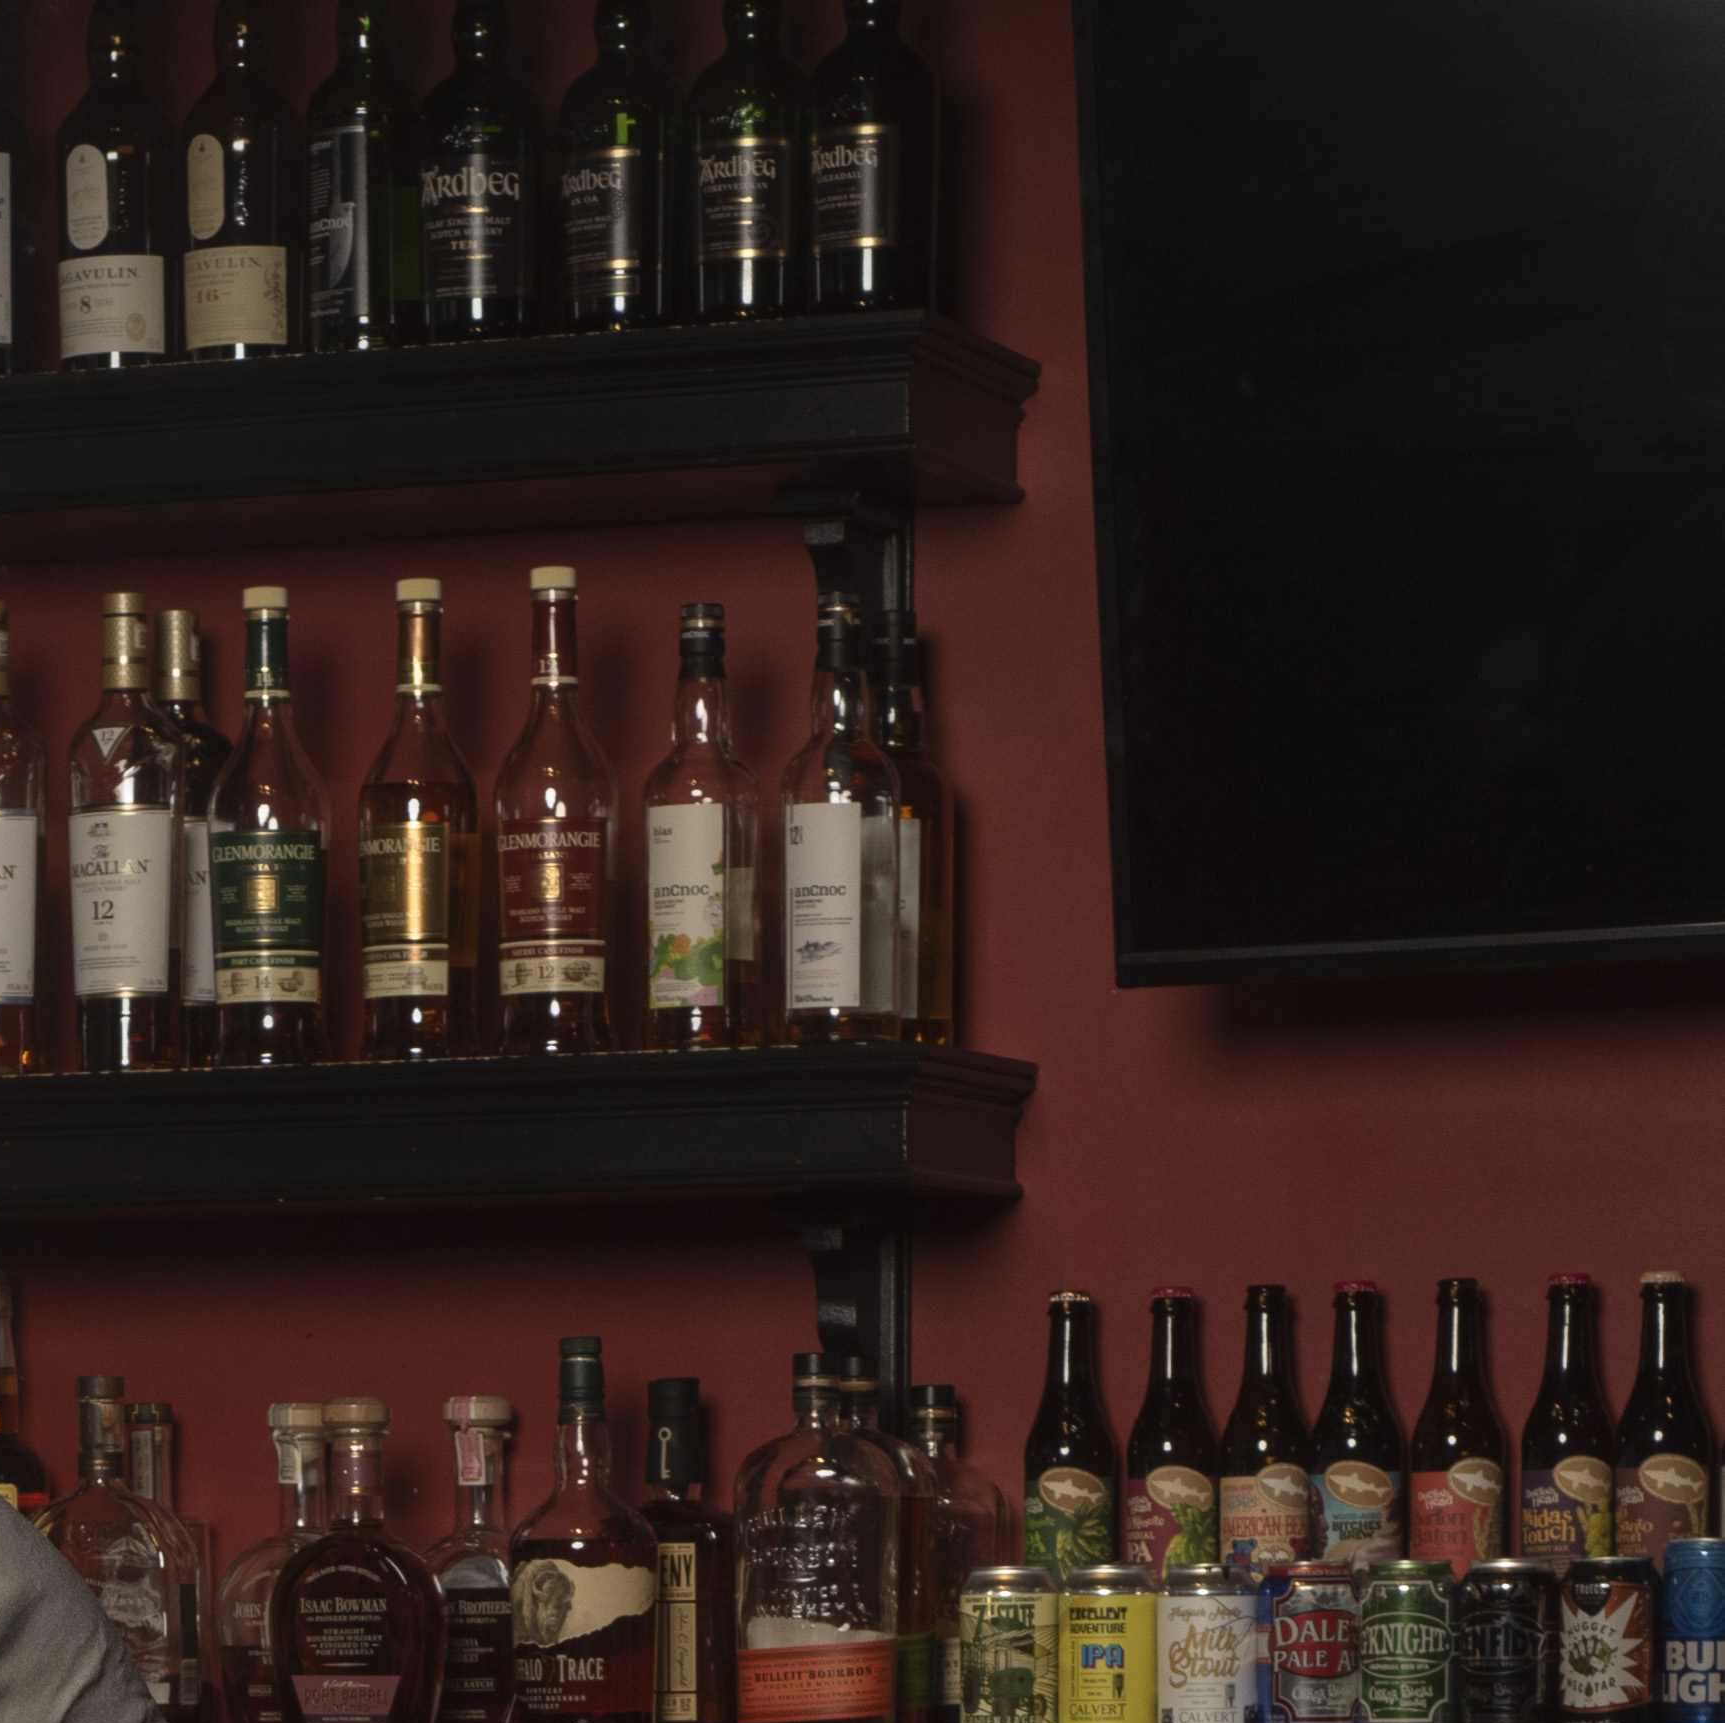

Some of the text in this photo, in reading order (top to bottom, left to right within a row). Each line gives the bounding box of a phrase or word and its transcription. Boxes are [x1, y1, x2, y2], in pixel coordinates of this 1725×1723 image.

[79, 294, 92, 313] 8
[654, 826, 673, 837] blas
[499, 831, 601, 850] GLENMORANGIE
[93, 845, 109, 859] The
[212, 843, 316, 864] GLENMORANGIE
[654, 884, 710, 898] anCnoc
[794, 884, 846, 898] anCnoc
[92, 900, 115, 921] 12
[270, 957, 296, 965] FINISH
[537, 965, 555, 979] 12
[254, 975, 272, 989] 14
[1332, 1520, 1381, 1531] BITCHES
[1523, 1508, 1573, 1528] Midas
[1340, 1530, 1374, 1541] BREW
[1524, 1522, 1576, 1544] Touch
[234, 1602, 262, 1620] JOHN
[299, 1597, 387, 1614] ISAAC BOWMAN
[1069, 1607, 1127, 1620] EXCELLENT
[1069, 1623, 1127, 1634] ADVENTURE
[1566, 1621, 1617, 1638] NUGGET
[346, 1634, 383, 1642] WHISKEY
[1185, 1625, 1238, 1652] Milk
[1080, 1643, 1125, 1669] IPA
[1274, 1650, 1328, 1673] PALE
[556, 1654, 605, 1682] TRACE
[1169, 1642, 1240, 1689] Stout
[754, 1666, 873, 1682] BULLEIT BOURBON
[463, 1681, 494, 1689] BATCH
[1566, 1678, 1617, 1695] NECTAR
[305, 1689, 389, 1703] PORT BARREL
[1069, 1703, 1127, 1716] CALVERT
[1179, 1711, 1237, 1723] CALVERT
